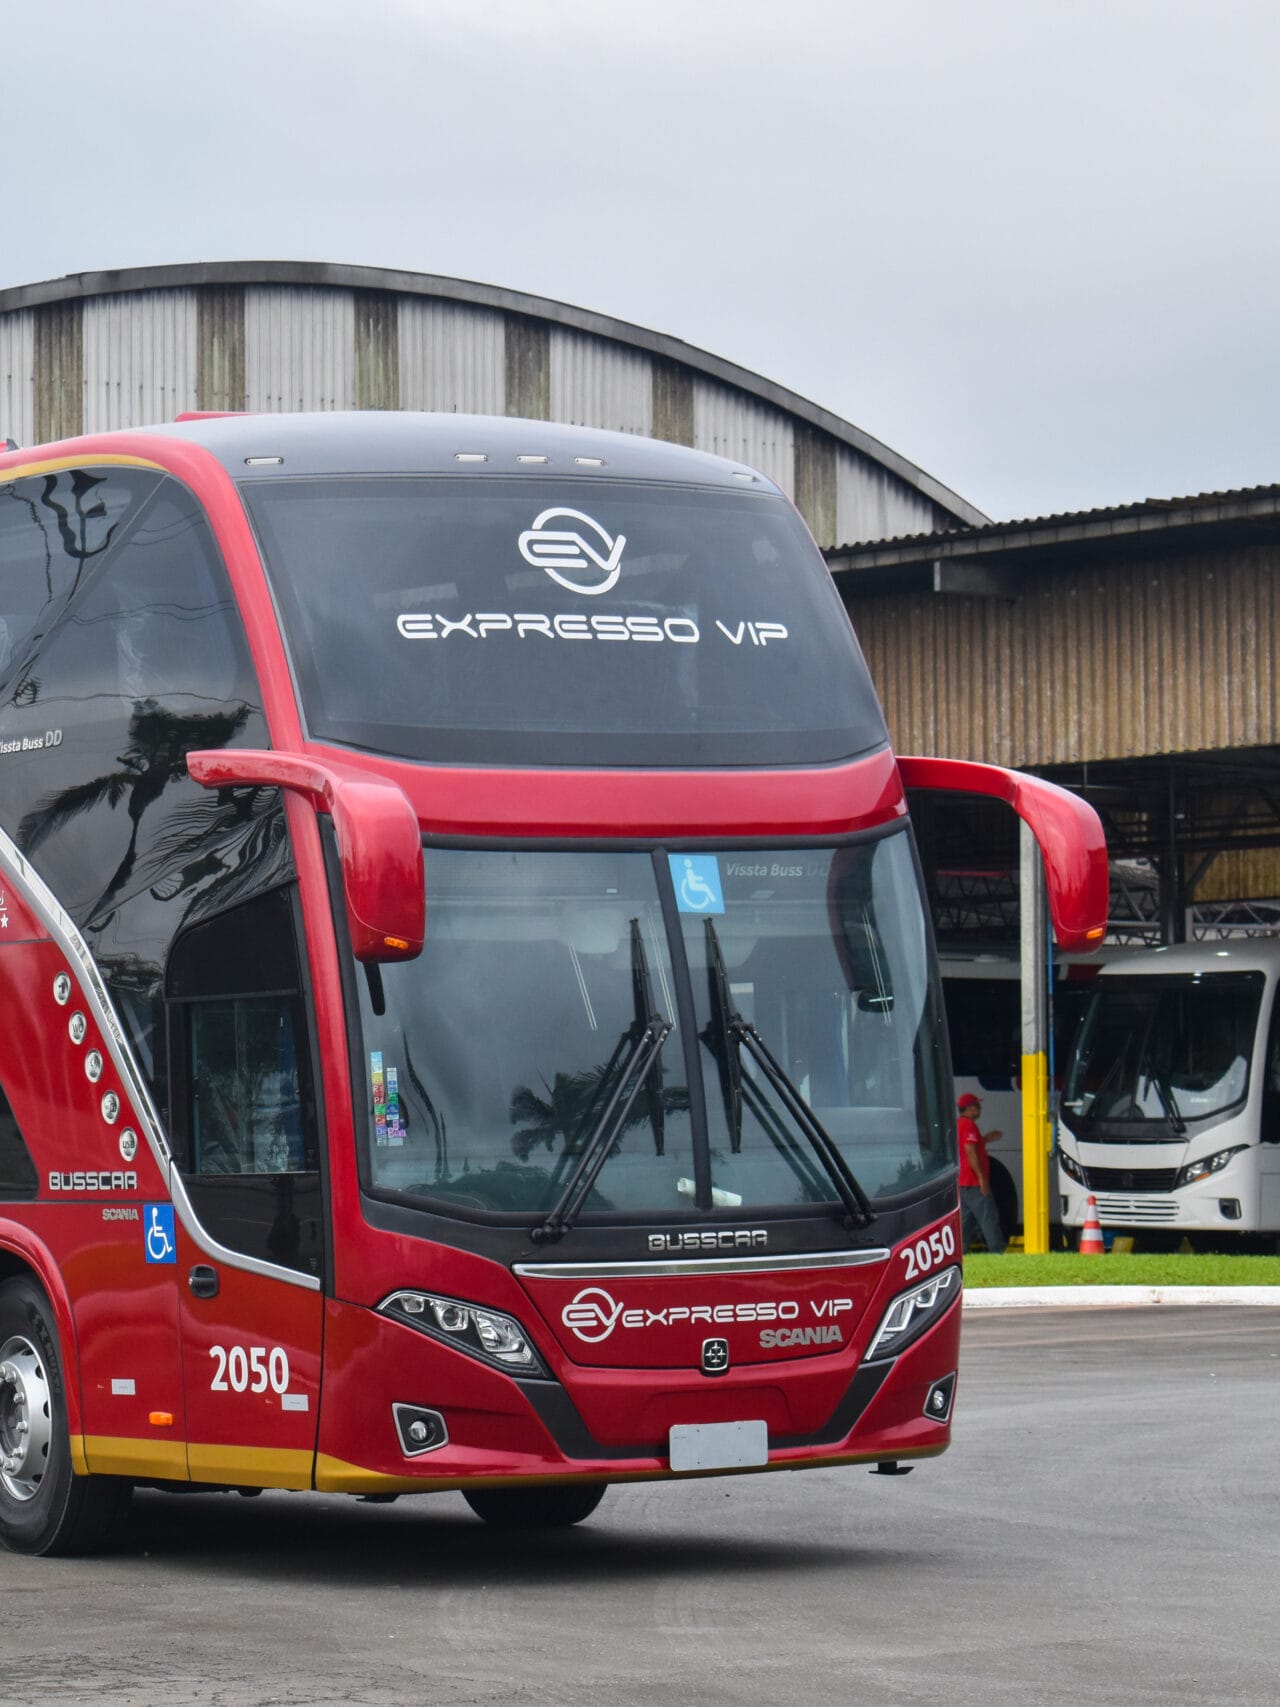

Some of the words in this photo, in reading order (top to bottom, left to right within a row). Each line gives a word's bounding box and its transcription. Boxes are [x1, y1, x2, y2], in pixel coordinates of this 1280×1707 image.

[396, 613, 700, 643] EXPRESSO
[715, 619, 789, 646] VIP
[22, 738, 44, 751] Buss
[45, 729, 63, 747] DD
[726, 862, 768, 876] Vissta
[770, 863, 804, 877] Buss
[48, 1170, 138, 1191] BUSSCAR
[101, 1207, 140, 1222] SCANIA
[647, 1230, 769, 1251] BUSSCAR
[900, 1224, 956, 1281] 2050
[622, 1303, 799, 1329] EXPRESSO
[809, 1298, 853, 1318] VIP
[759, 1324, 843, 1349] SCANIA
[208, 1345, 290, 1394] 2050
